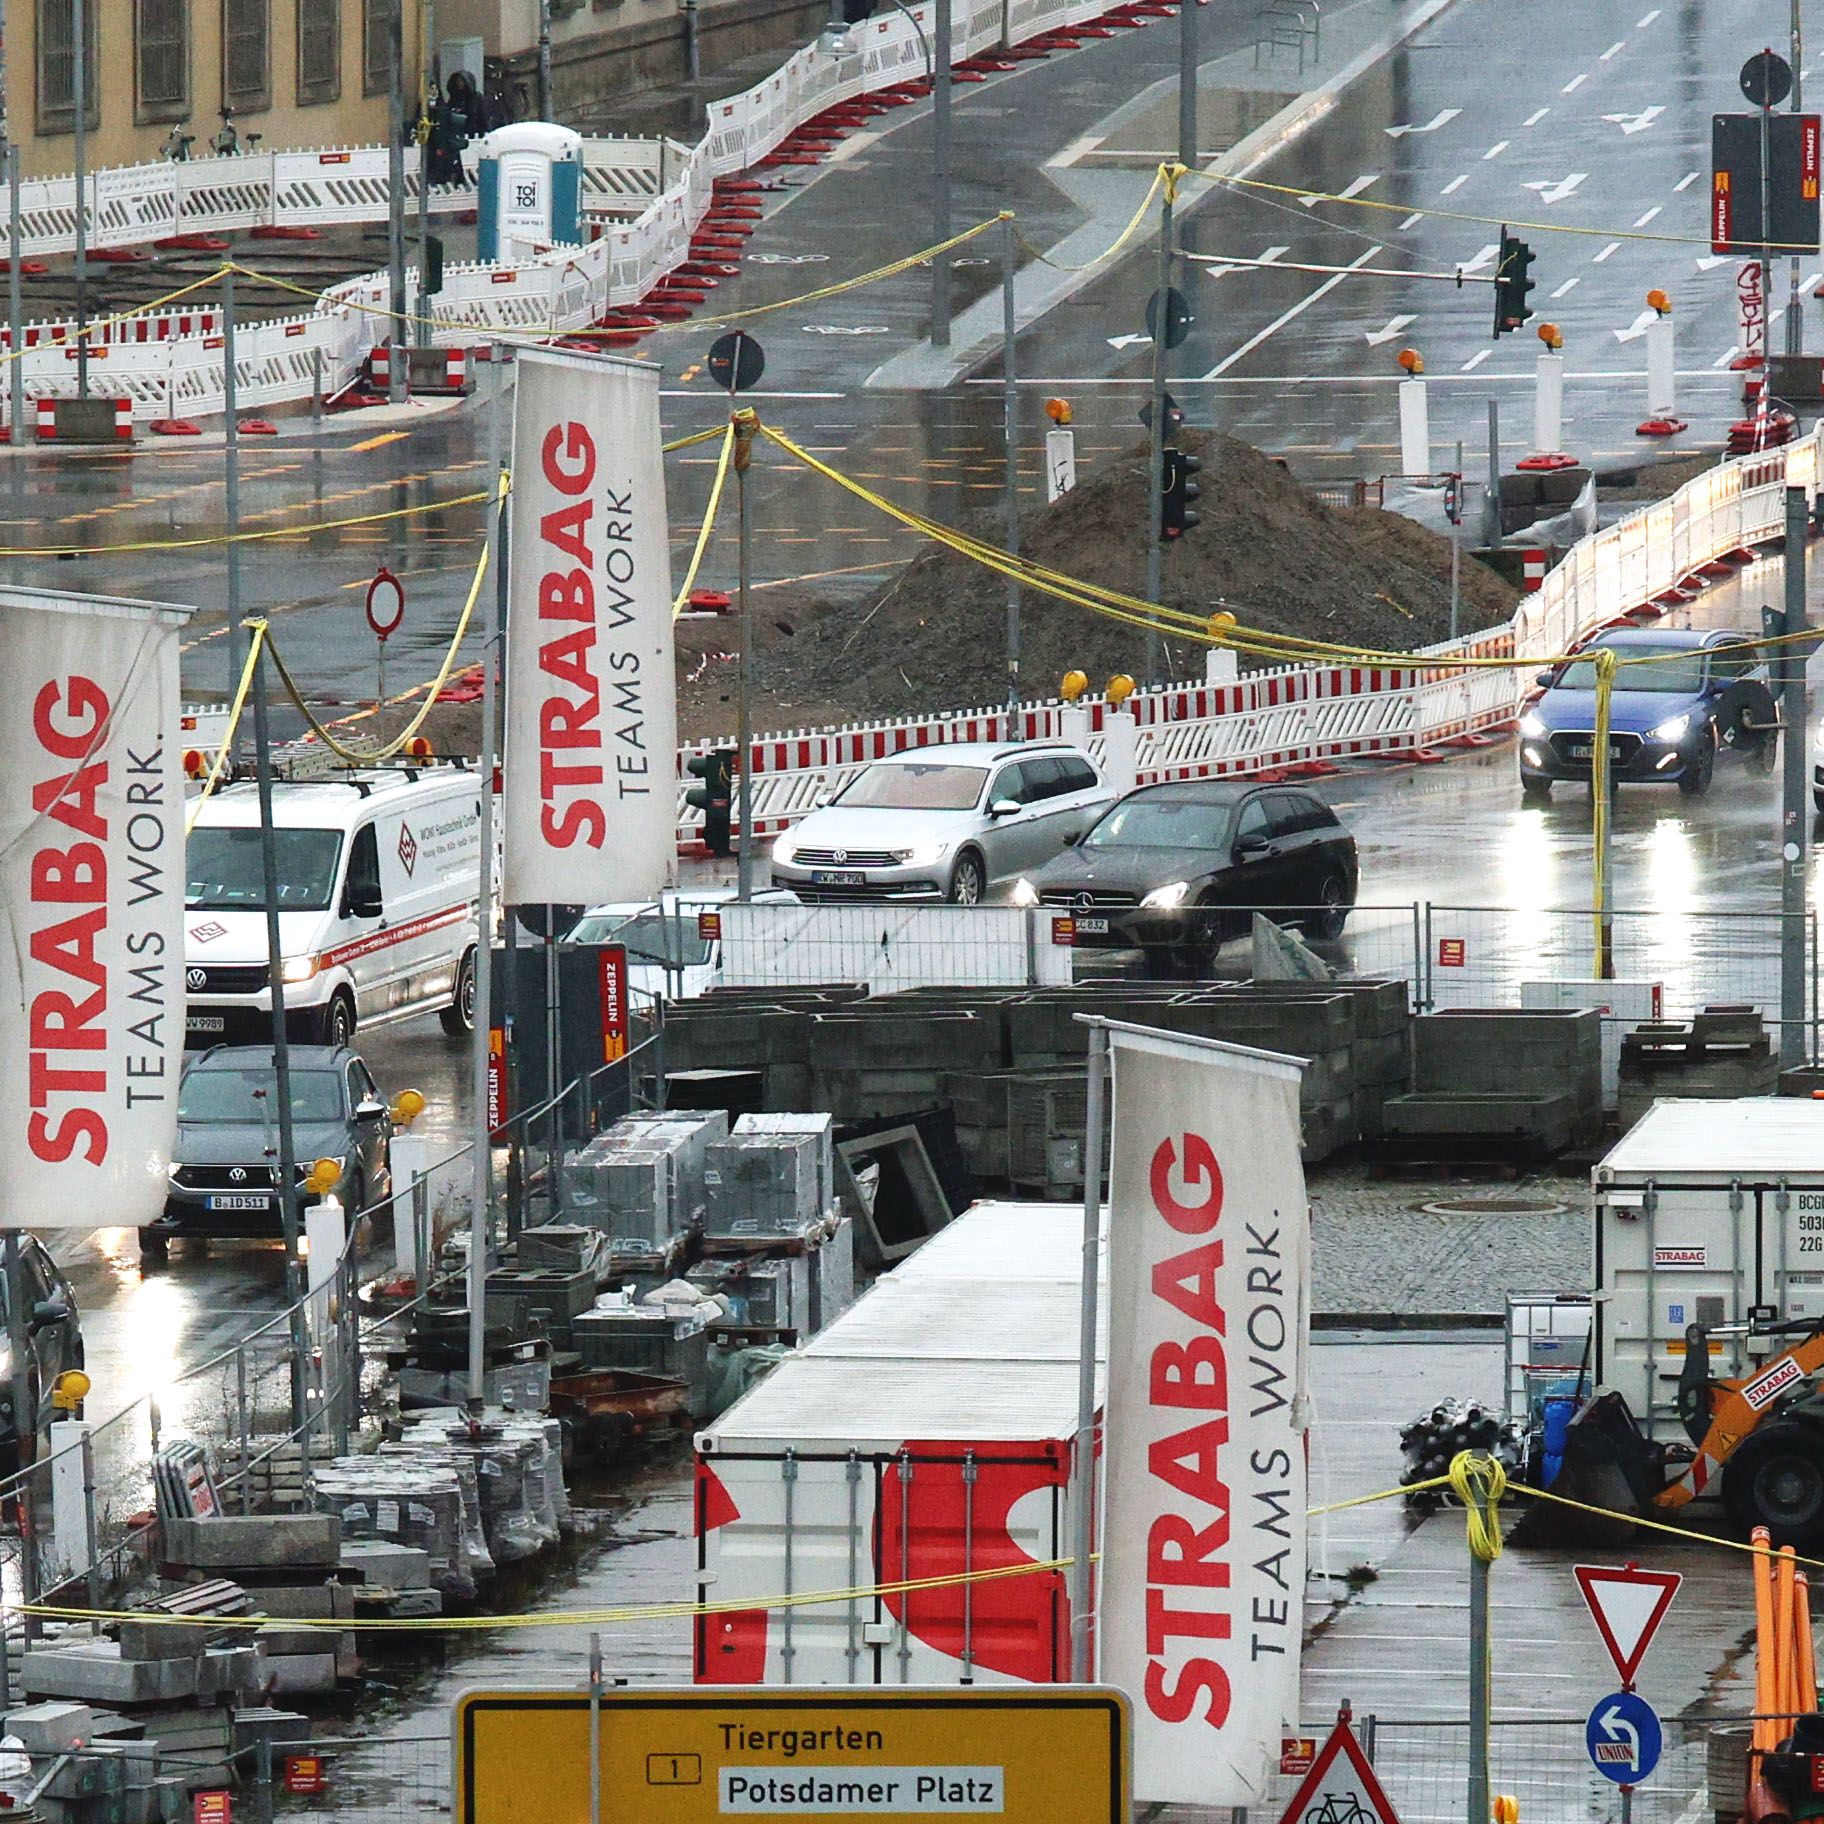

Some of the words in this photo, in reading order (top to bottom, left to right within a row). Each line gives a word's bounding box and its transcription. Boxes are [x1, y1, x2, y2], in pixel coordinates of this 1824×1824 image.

[1805, 126, 1816, 172] ZEPPELIN
[1716, 198, 1727, 243] ZEPPELIN
[539, 419, 606, 851] STRABAG
[617, 653, 651, 801] TEAMS
[25, 674, 110, 1169] STRABAG
[1087, 919, 1105, 930] 832
[605, 963, 619, 1023] ZEPPELIN
[123, 933, 165, 1110] TEAMS
[489, 1068, 499, 1129] ZEPPELIN
[214, 1197, 222, 1209] B
[244, 1197, 265, 1209] 511
[1654, 1251, 1706, 1262] STRABAG
[1748, 1364, 1798, 1404] STRABAG
[1143, 1131, 1233, 1731] STRABAG
[1249, 1446, 1291, 1663] TEAMS
[719, 1723, 883, 1755] Tiergarten
[1597, 1744, 1633, 1762] UNION
[670, 1759, 679, 1780] 1
[727, 1776, 900, 1805] Potsdamer
[916, 1776, 995, 1805] Platz
